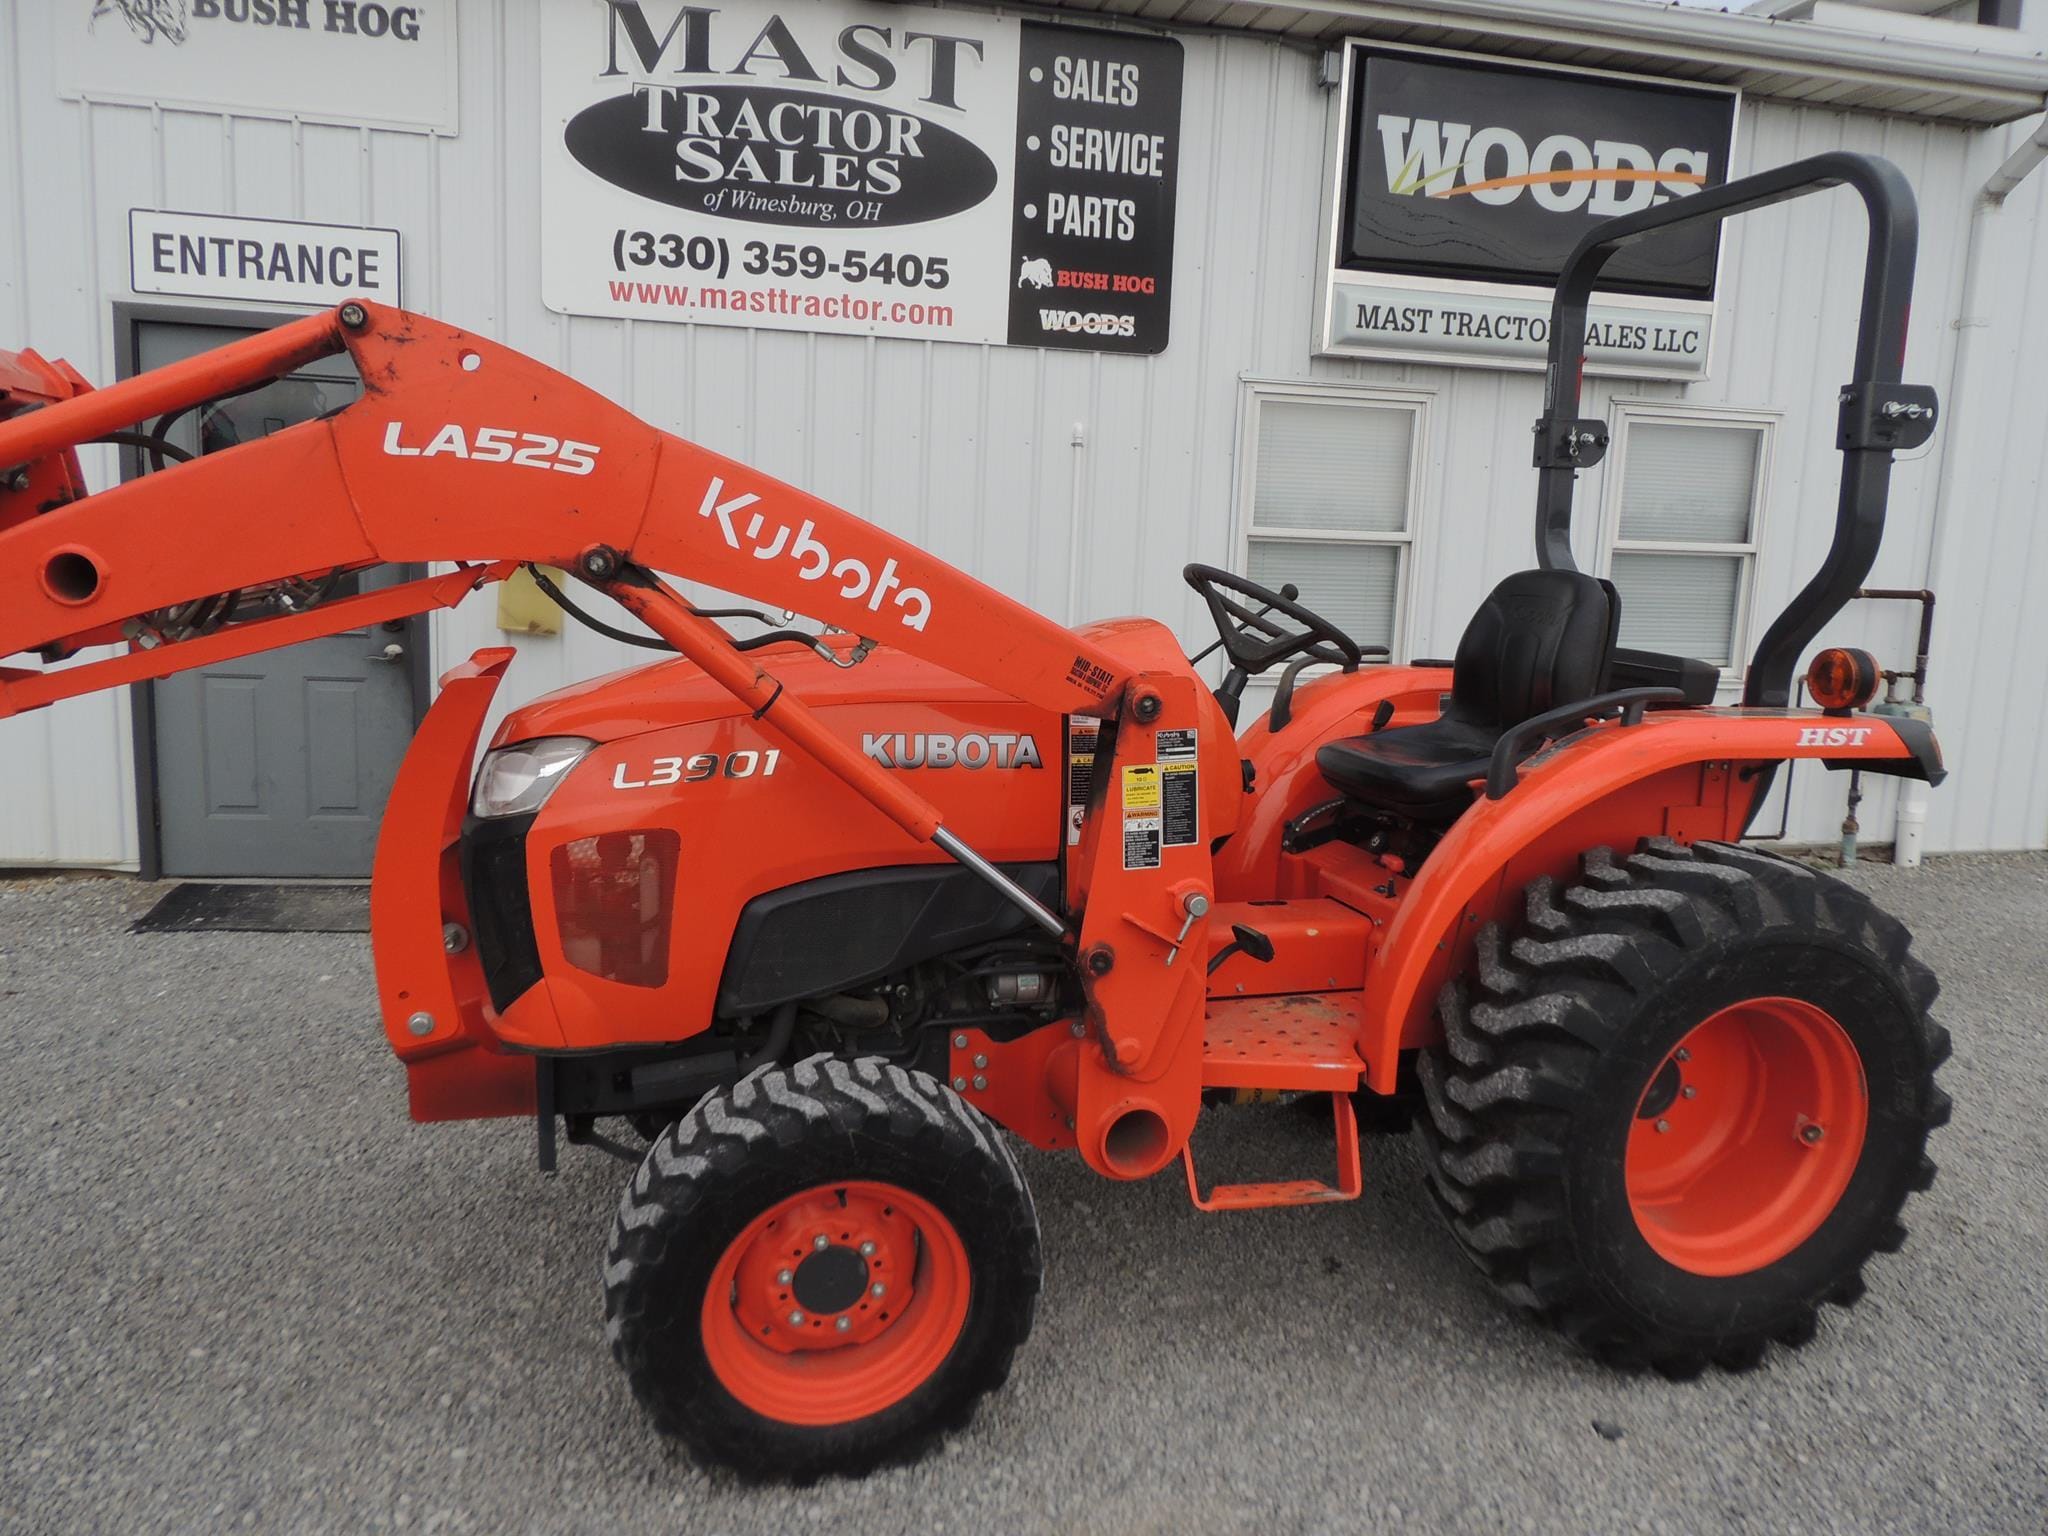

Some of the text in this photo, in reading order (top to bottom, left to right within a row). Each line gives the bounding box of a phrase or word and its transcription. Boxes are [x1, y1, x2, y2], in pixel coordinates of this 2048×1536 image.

[192, 0, 421, 41] BUSH HOG
[599, 0, 984, 112] MAST
[1053, 56, 1140, 107] SALES
[632, 82, 925, 158] TRACTOR
[675, 137, 902, 195] SALES
[1050, 124, 1165, 177] SERVICE
[1377, 114, 1709, 217] WOODS
[703, 188, 884, 222] of Winesburg, OH
[1047, 192, 1136, 241] PARTS
[152, 232, 380, 289] ENTRANCE
[613, 229, 950, 290] (330) 359-5405
[1057, 270, 1156, 295] BUSH HOG
[608, 280, 954, 327] www.masttractor.com
[1039, 308, 1135, 337] WOODS
[1355, 303, 1699, 353] MAST TRACTO ALES LLC
[383, 421, 601, 476] LA525
[698, 475, 932, 632] Kubota
[1074, 655, 1115, 686] MID-STATE
[861, 733, 1044, 769] KUBOTA
[1796, 727, 1872, 747] HST
[613, 749, 781, 789] L3901
